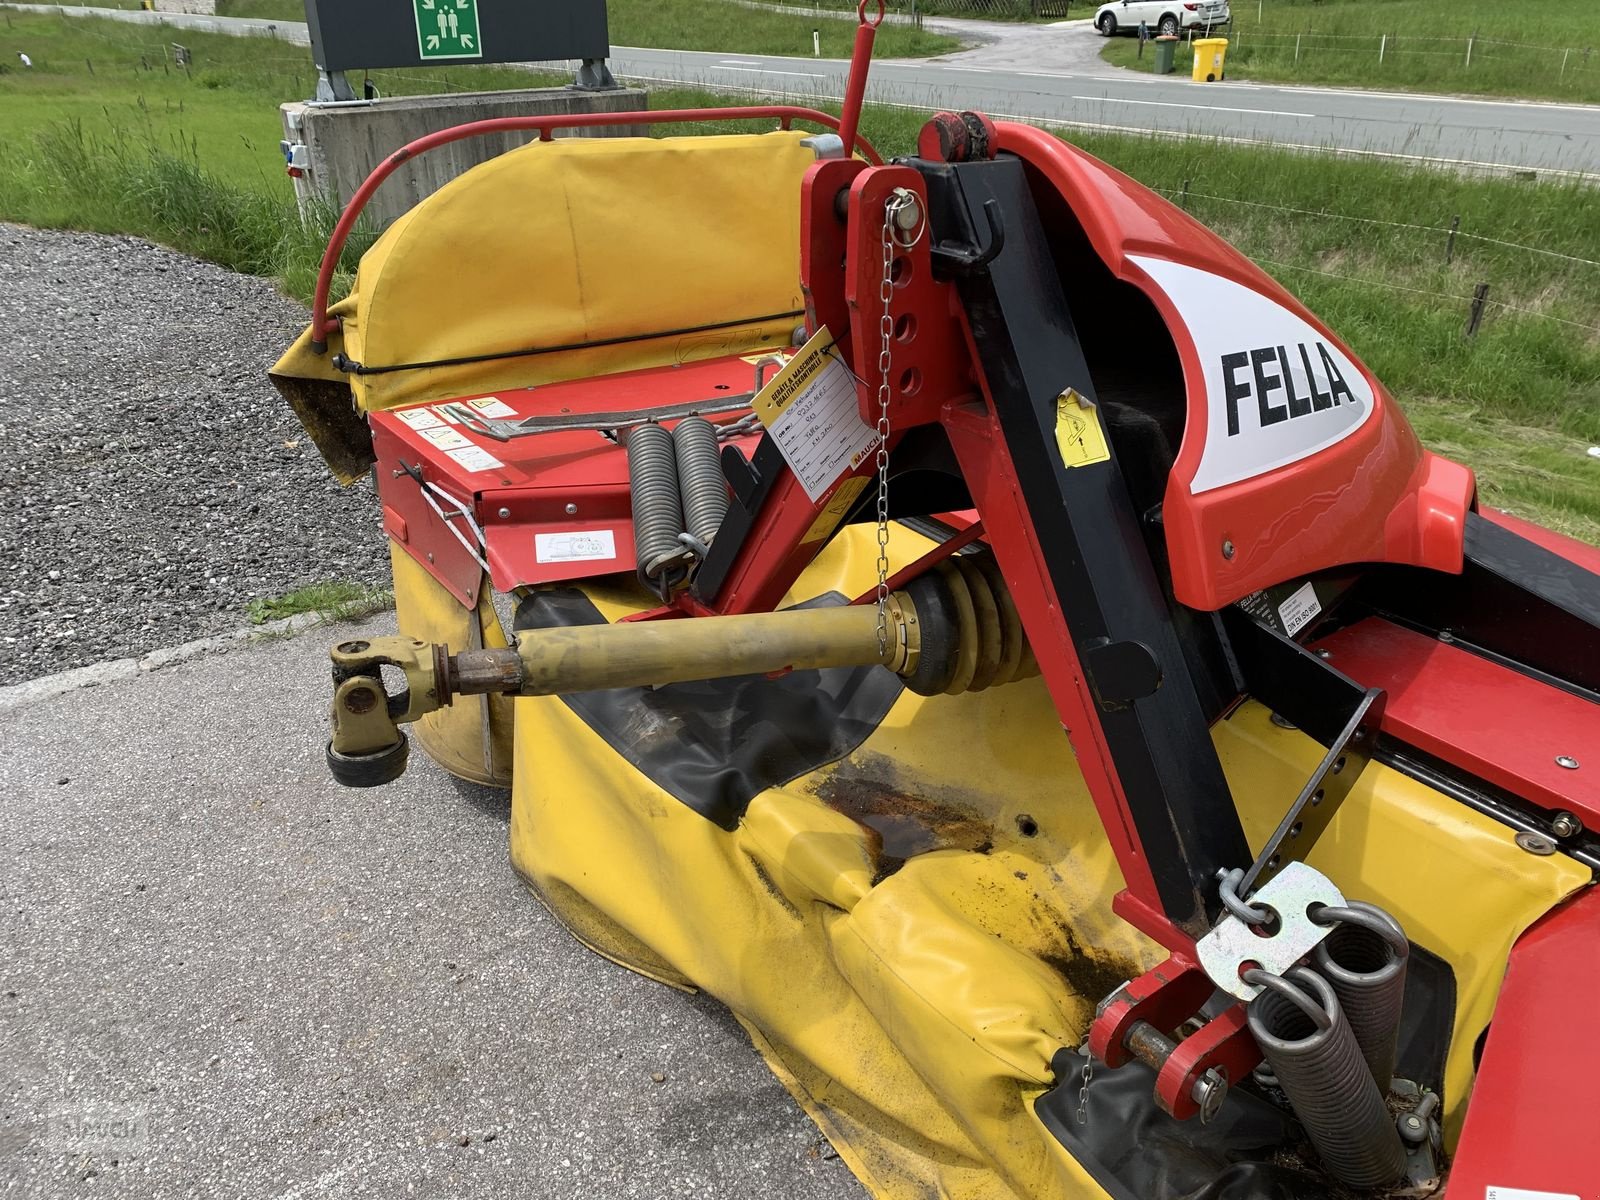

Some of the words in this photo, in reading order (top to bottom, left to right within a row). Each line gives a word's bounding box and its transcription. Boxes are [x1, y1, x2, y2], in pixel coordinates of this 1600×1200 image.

[771, 380, 789, 401] GERÄTE
[792, 350, 819, 380] MASCHINEN
[776, 358, 822, 407] QUALITÄTSKONTROLLE
[1221, 342, 1355, 437] FELLA
[854, 436, 879, 464] MAUCH
